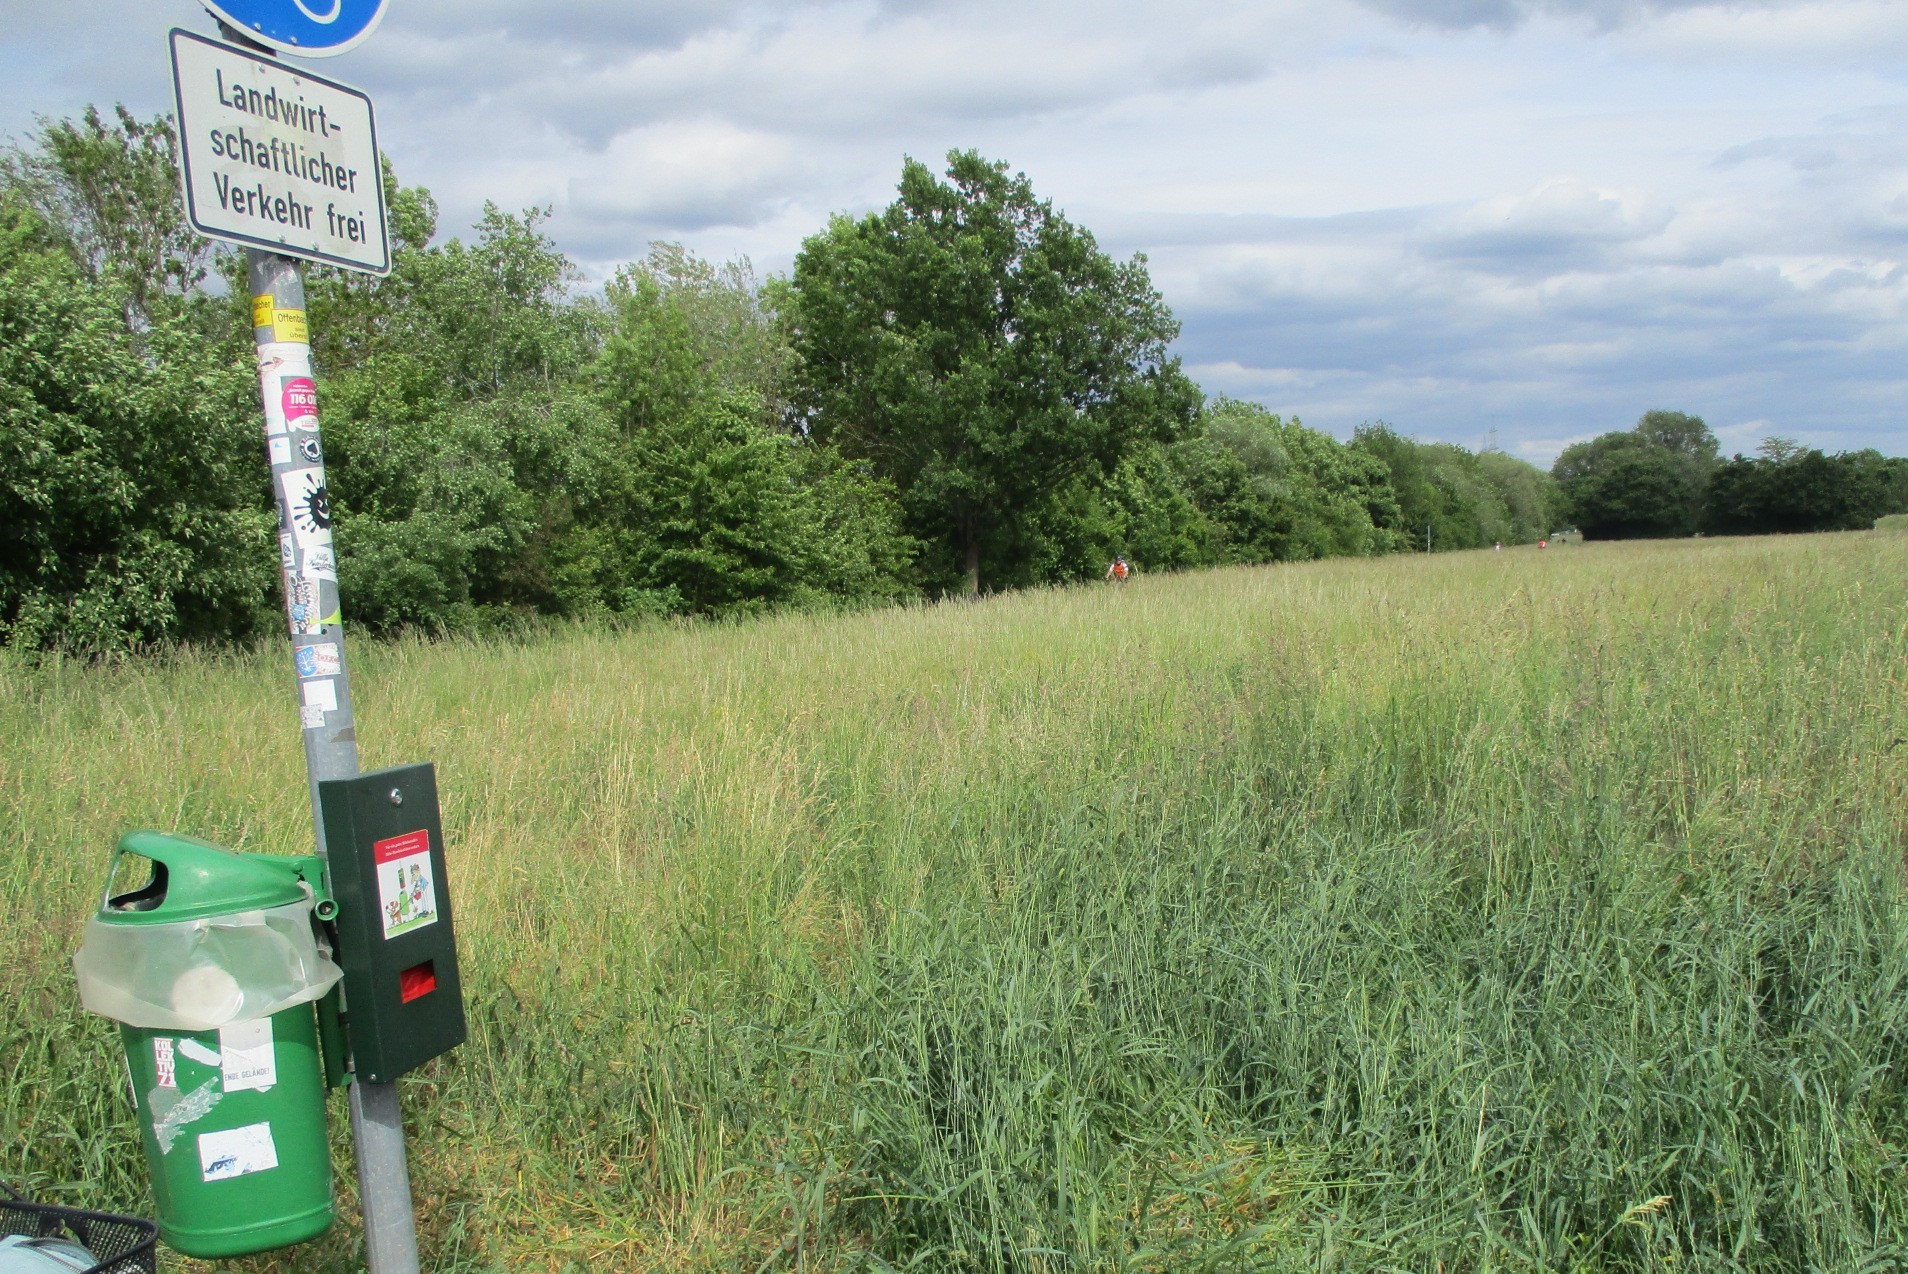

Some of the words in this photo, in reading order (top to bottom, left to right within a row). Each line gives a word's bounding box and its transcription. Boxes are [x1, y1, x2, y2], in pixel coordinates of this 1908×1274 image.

[216, 68, 342, 138] Landwirt-
[210, 127, 358, 194] schaftlicher
[213, 171, 314, 231] Verkehr
[327, 203, 367, 244] frei
[290, 393, 307, 405] 116
